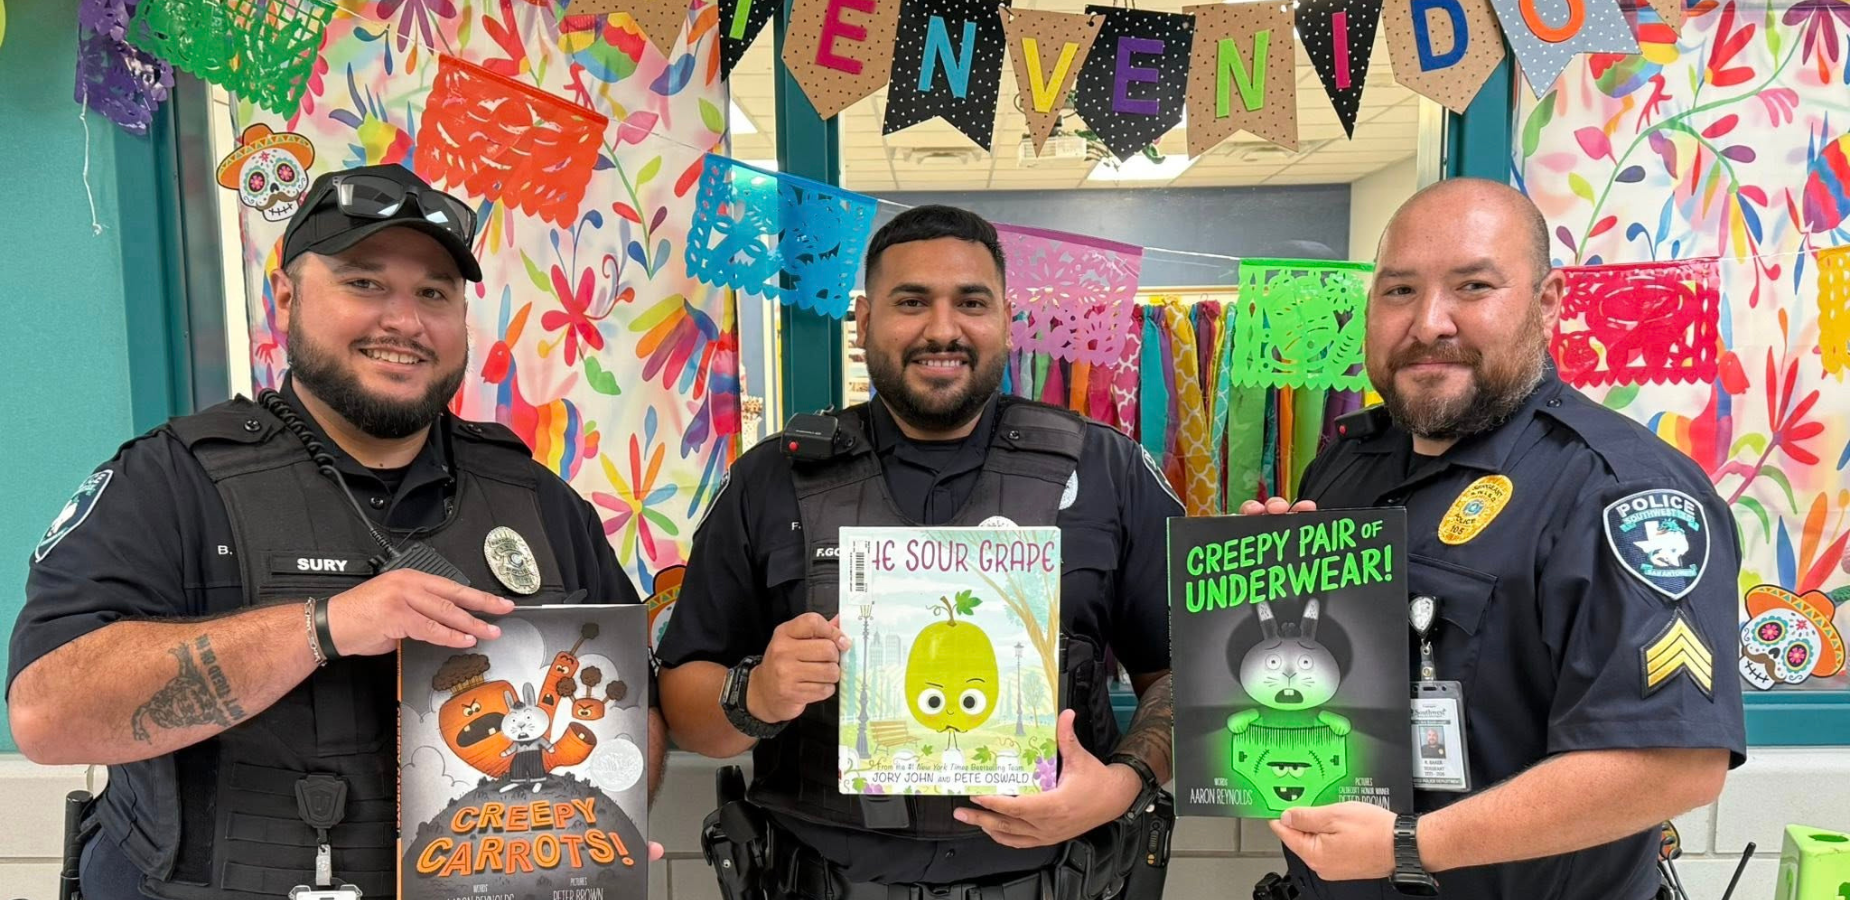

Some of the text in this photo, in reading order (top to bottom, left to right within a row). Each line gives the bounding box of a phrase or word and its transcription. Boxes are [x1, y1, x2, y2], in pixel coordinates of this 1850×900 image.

[1616, 494, 1695, 517] POLICE
[1455, 513, 1476, 524] POLICE
[1623, 508, 1676, 524] SOUTHWEST
[217, 545, 233, 555] B.
[1187, 518, 1383, 576] CREEPY PAIR OF
[297, 558, 348, 571] SURY
[871, 540, 895, 572] HE
[905, 539, 969, 572] SOUR
[979, 539, 1055, 573] GRAPE
[1185, 544, 1393, 613] UNDERWEAR!
[876, 763, 893, 771] From
[934, 763, 947, 771] York
[950, 763, 968, 771] Times
[872, 772, 901, 783] JORY
[904, 772, 934, 783] JOHN
[954, 773, 981, 783] PETE
[985, 773, 1029, 784] OSWALD
[1190, 788, 1253, 805] AARON REYNOLDS
[451, 798, 596, 833] CREEPY
[417, 828, 634, 878] CARROTS!
